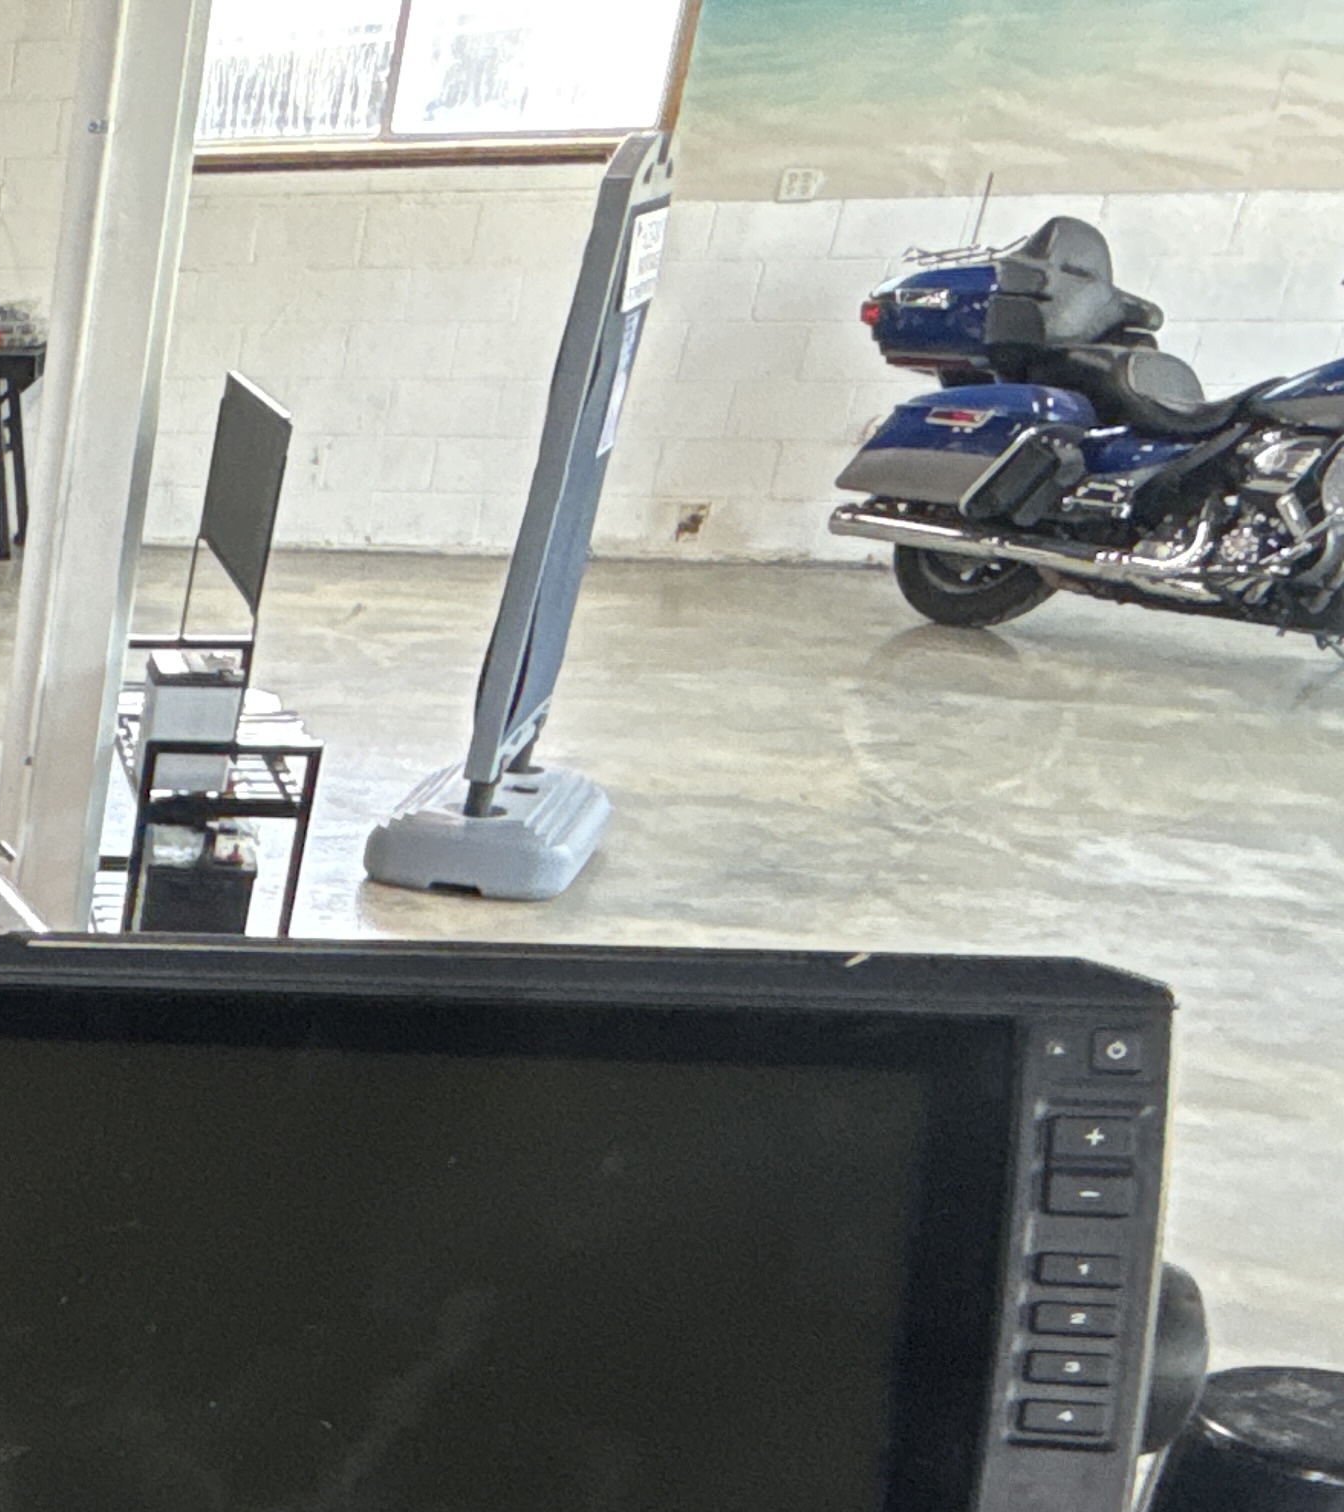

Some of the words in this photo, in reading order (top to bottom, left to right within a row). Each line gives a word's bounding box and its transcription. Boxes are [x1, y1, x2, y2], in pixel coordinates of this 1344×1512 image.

[1077, 1262, 1089, 1276] 1
[1069, 1311, 1086, 1325] 2
[1064, 1361, 1081, 1373] 3
